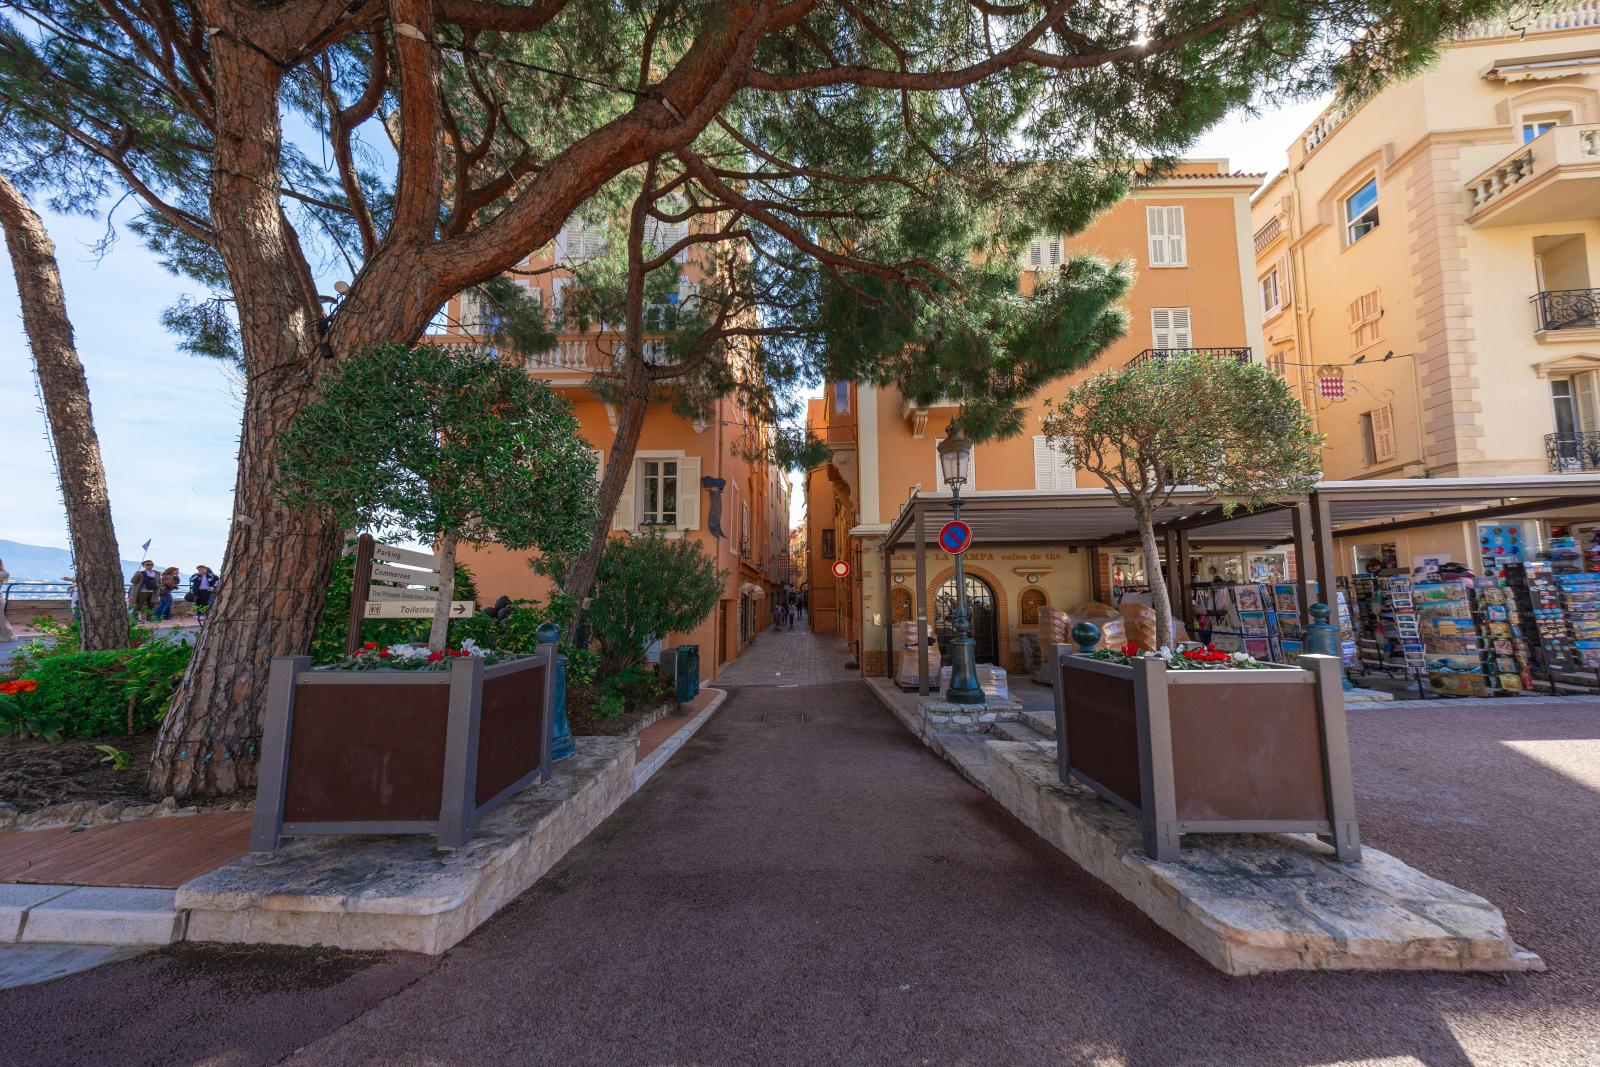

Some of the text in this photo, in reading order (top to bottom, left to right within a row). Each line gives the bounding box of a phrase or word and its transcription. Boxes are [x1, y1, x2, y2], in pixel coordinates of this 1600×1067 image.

[377, 548, 401, 559] Parking
[879, 553, 907, 561] sack
[957, 553, 994, 561] AMPA
[1000, 553, 1027, 561] salon
[1030, 553, 1041, 561] de
[374, 568, 410, 580] Commerces
[400, 605, 435, 614] Toilettes
